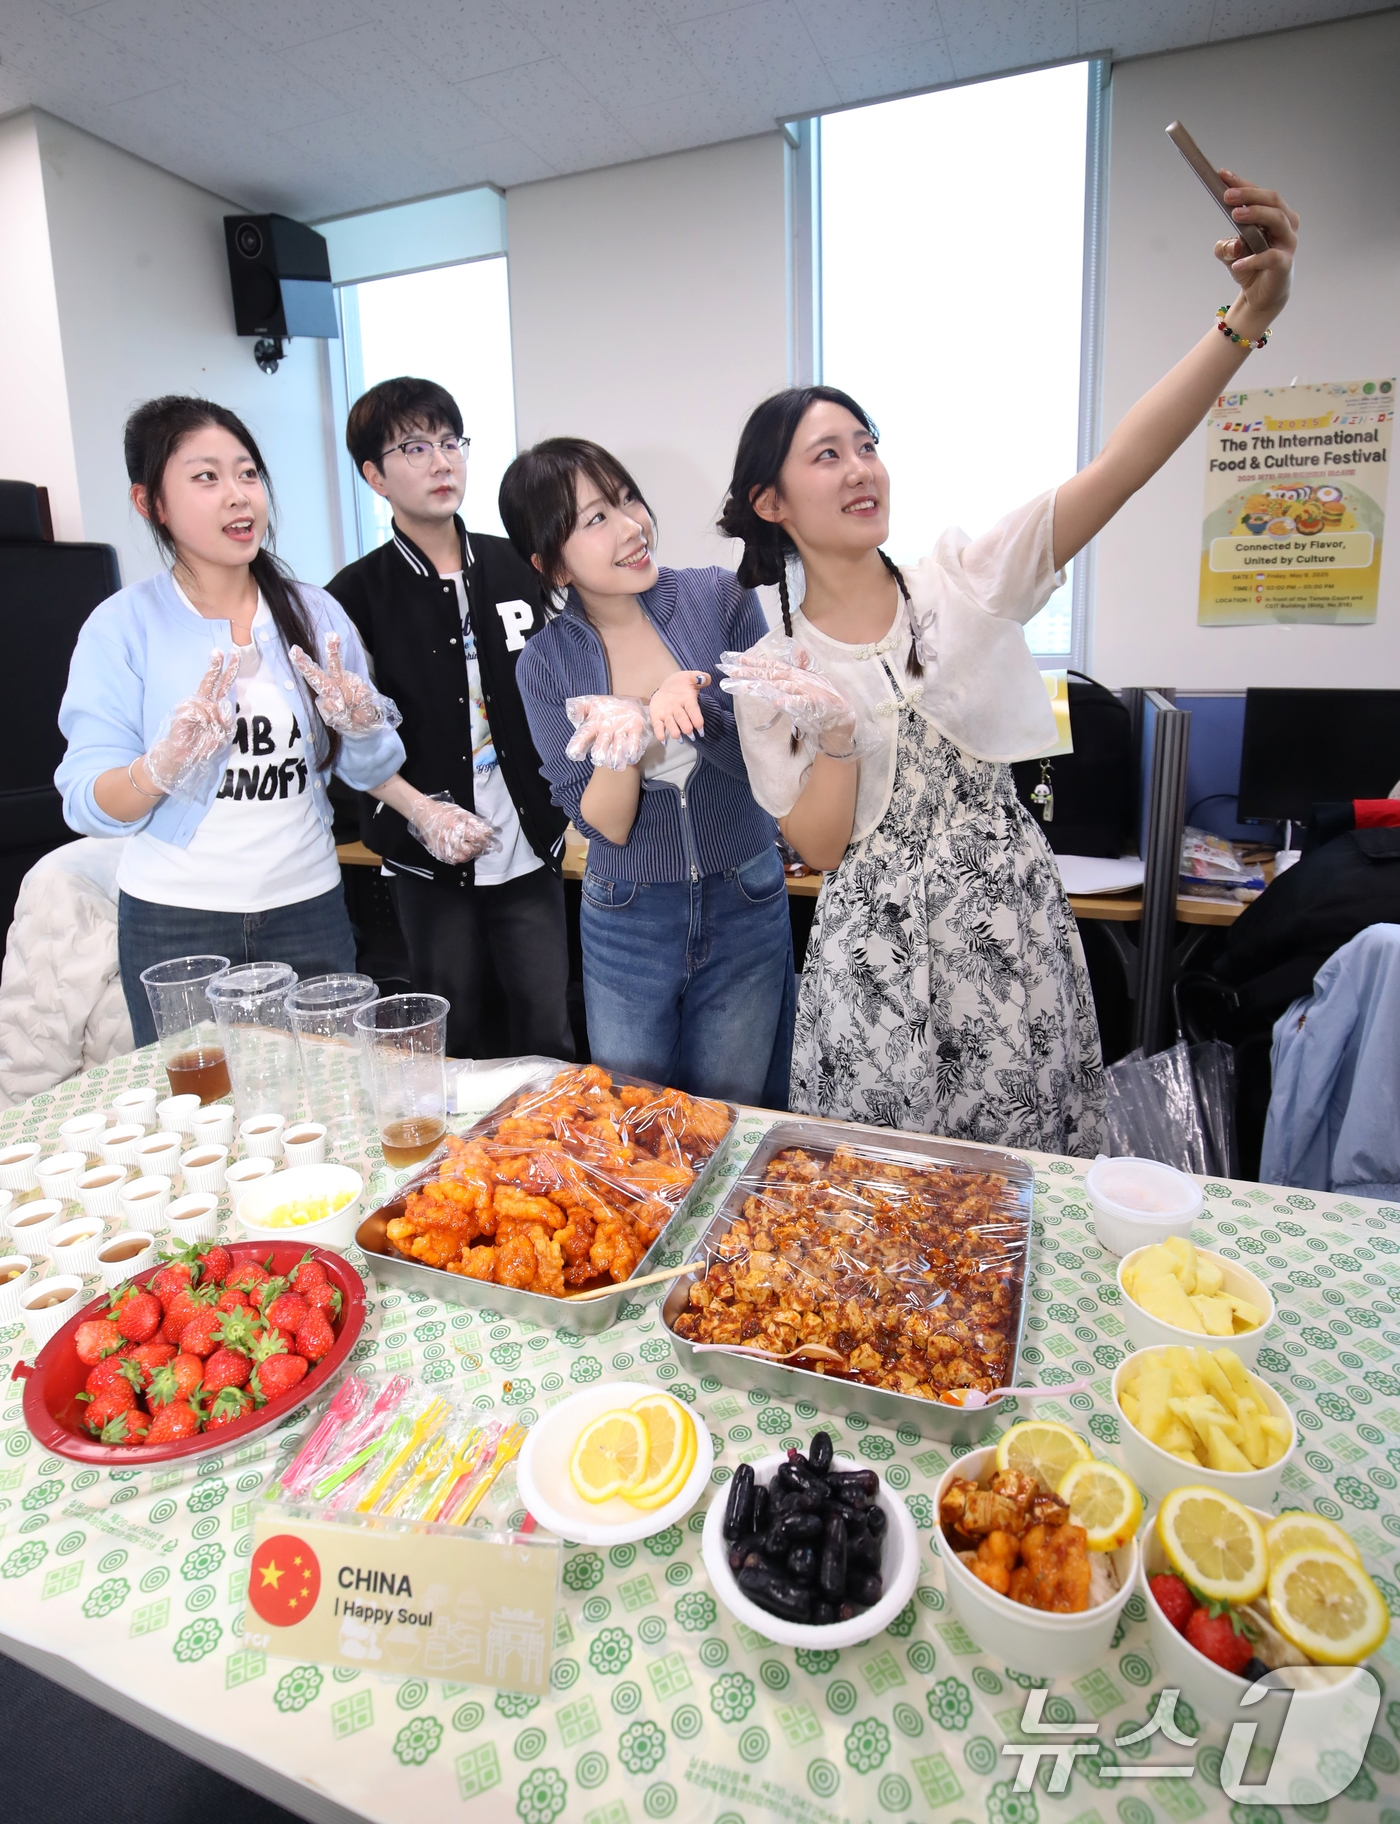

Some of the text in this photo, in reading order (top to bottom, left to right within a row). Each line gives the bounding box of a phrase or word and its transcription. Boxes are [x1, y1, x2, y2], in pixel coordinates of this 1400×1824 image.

[1277, 418, 1320, 429] 2025
[1220, 429, 1379, 452] The 7th International
[1209, 448, 1387, 472] Food & Culture Festival
[1237, 475, 1256, 483] 2025
[1235, 539, 1346, 552] Connected by Flavor,
[1244, 554, 1336, 566] United by Culture
[1289, 572, 1303, 580] May
[495, 599, 534, 652] P
[337, 1566, 413, 1598] CHINA
[343, 1600, 393, 1626] Happy
[397, 1606, 433, 1627] Soul
